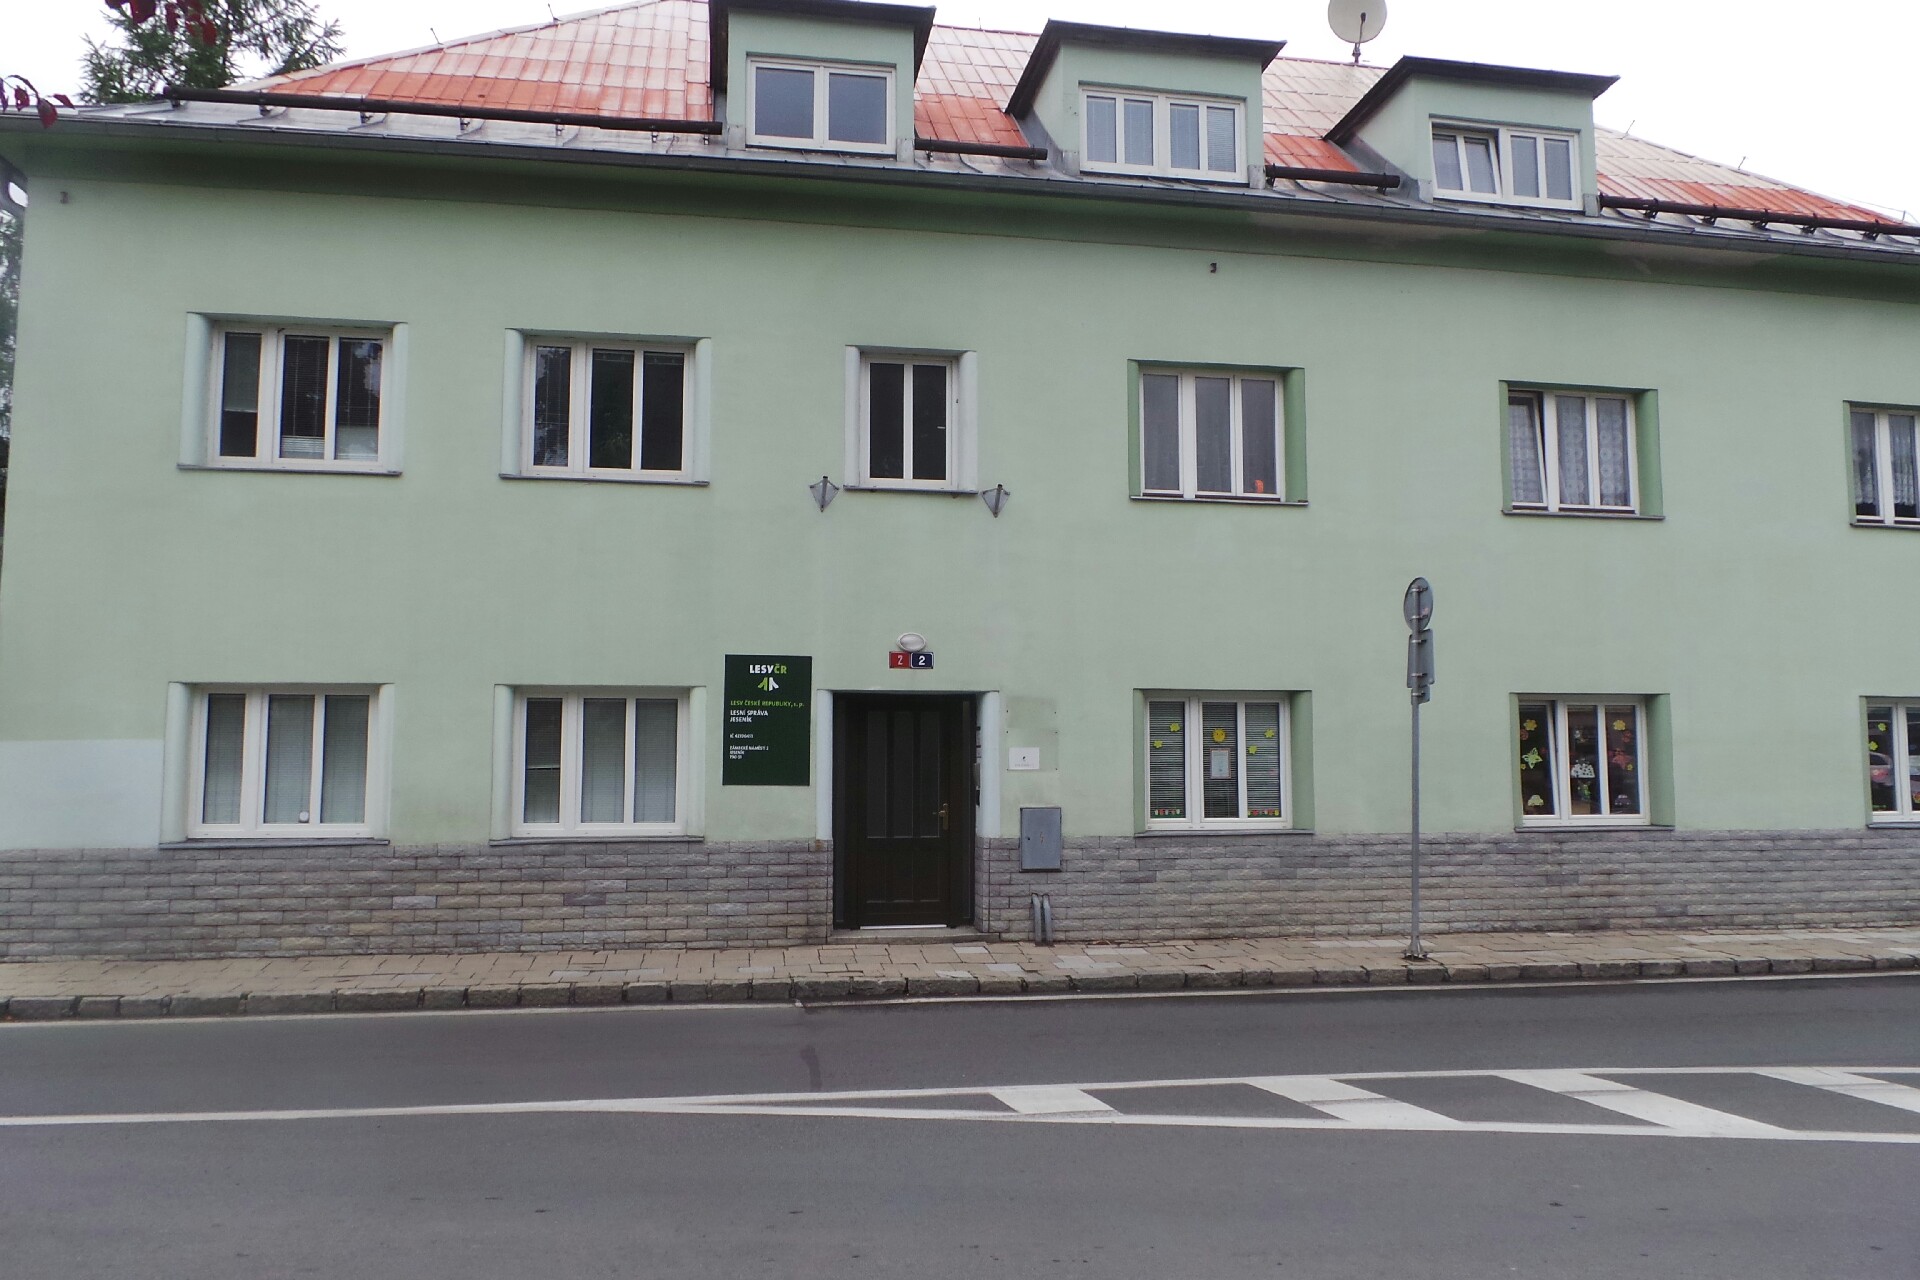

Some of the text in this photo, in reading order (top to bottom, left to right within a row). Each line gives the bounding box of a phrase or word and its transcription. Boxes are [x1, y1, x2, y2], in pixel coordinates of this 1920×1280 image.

[898, 654, 903, 666] 2
[918, 656, 926, 666] 2
[746, 709, 769, 717] SPRÁVA
